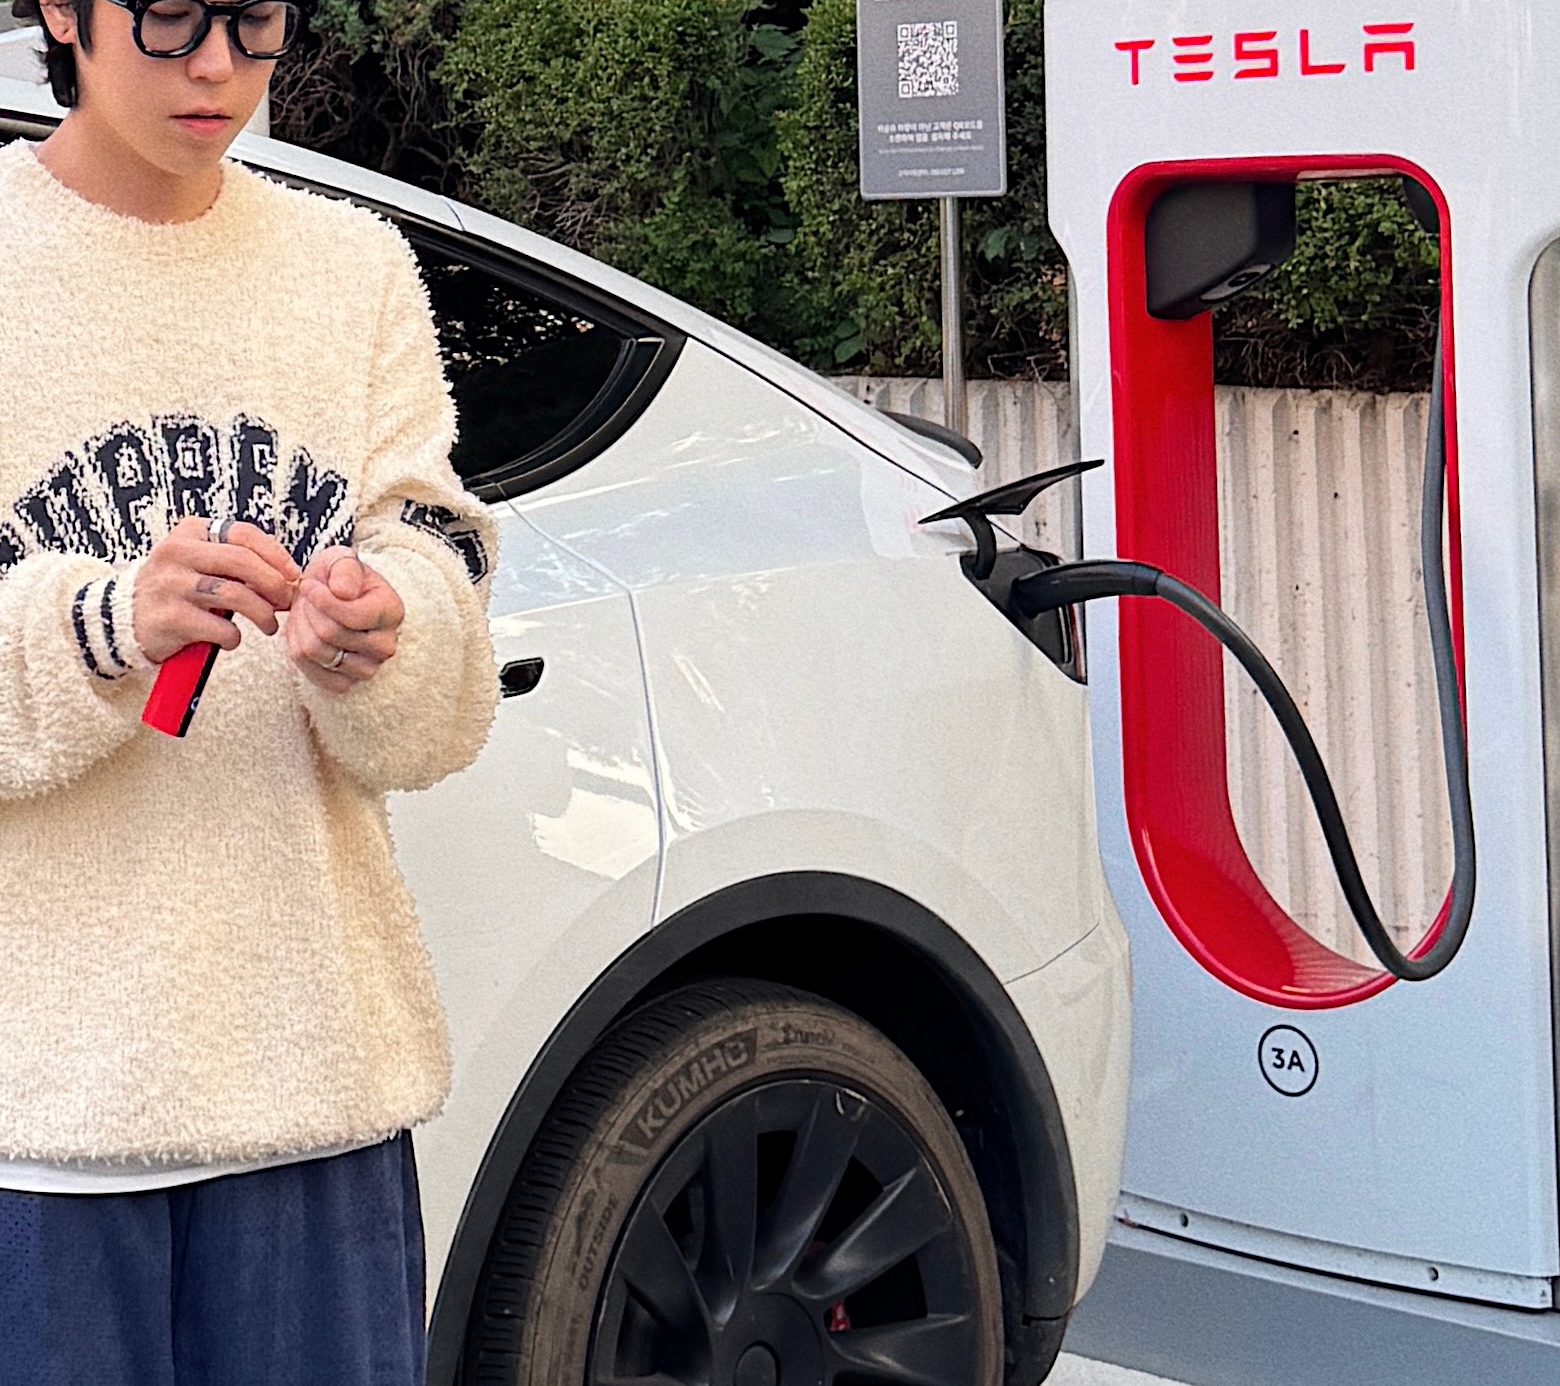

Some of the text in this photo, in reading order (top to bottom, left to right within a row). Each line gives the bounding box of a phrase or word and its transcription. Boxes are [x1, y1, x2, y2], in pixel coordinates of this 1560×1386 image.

[1113, 22, 1415, 86] TESLA
[637, 1040, 749, 1140] KUMHO
[1271, 1047, 1305, 1073] 3A
[577, 1191, 620, 1292] OUTSIDE
